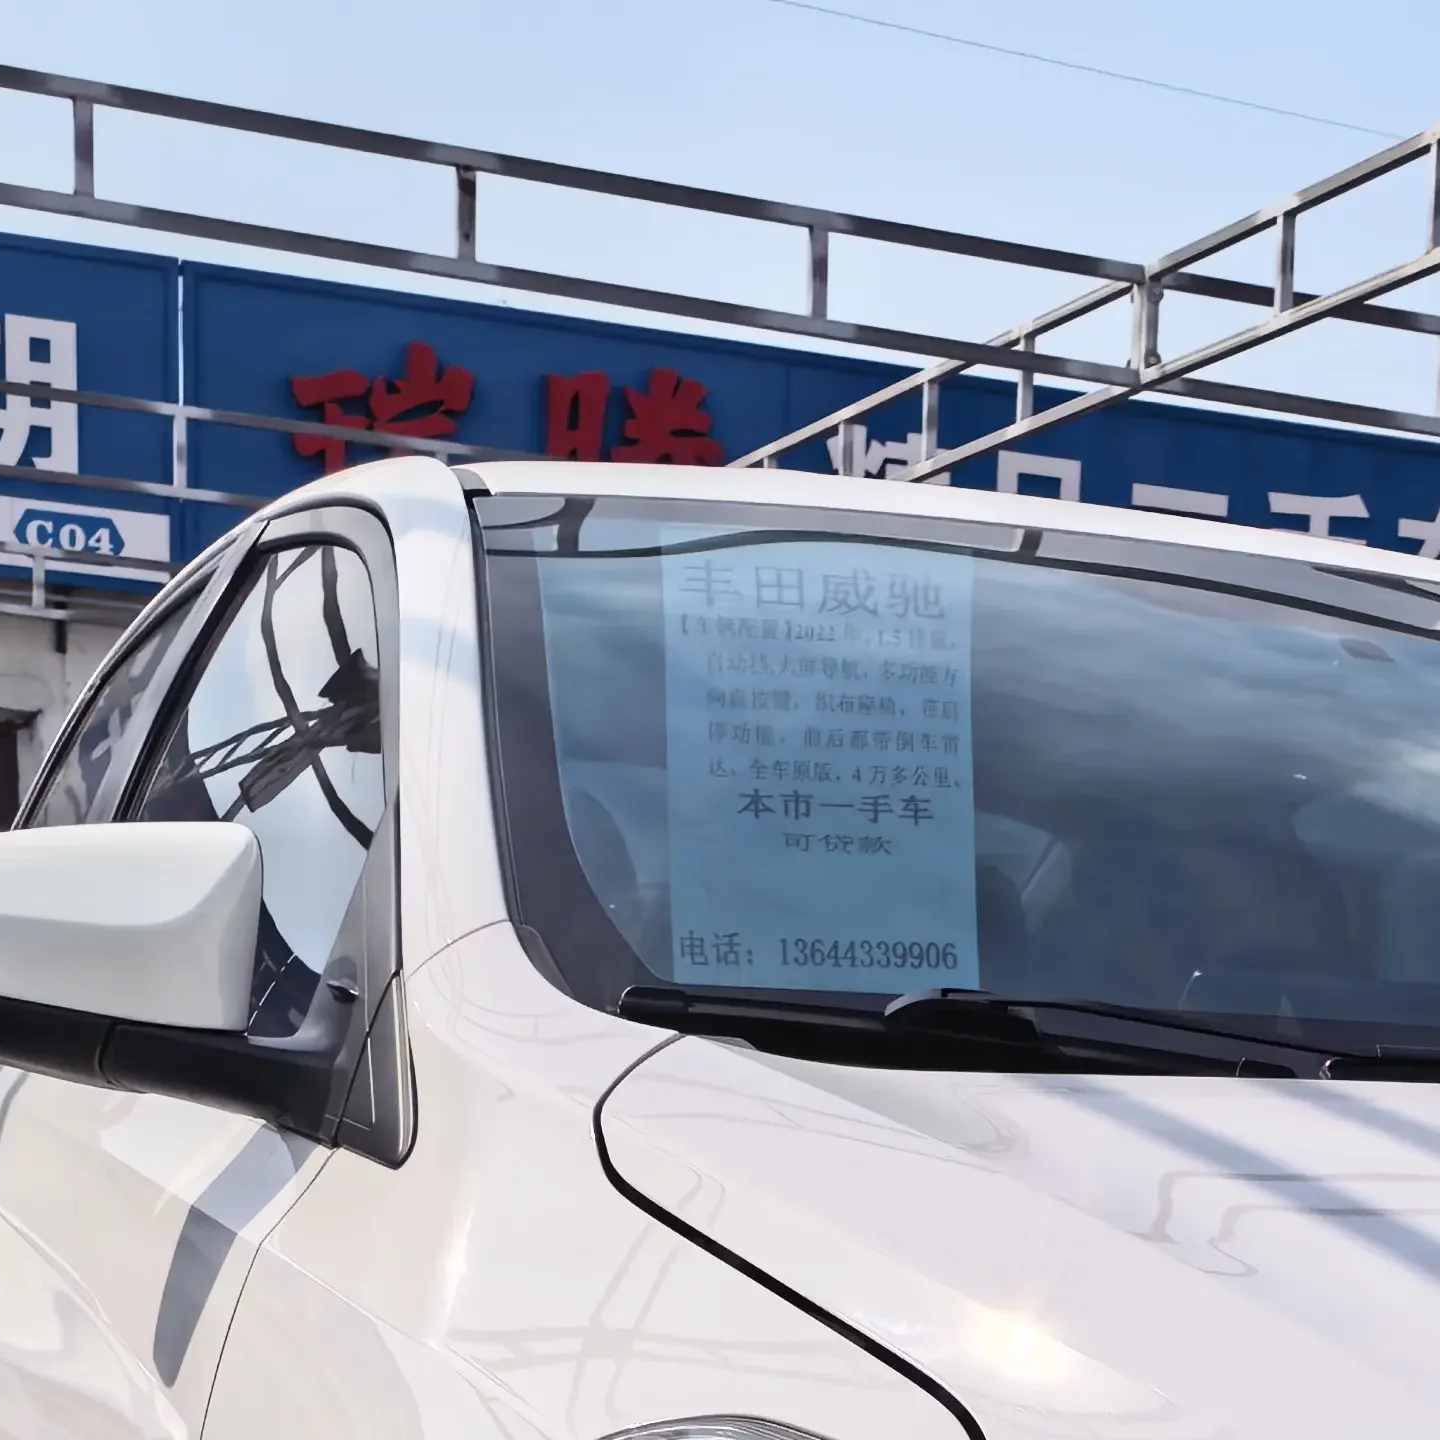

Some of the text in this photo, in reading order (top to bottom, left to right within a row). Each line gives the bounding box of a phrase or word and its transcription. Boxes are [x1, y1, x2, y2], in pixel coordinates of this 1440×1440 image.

[24, 518, 116, 556] C04
[677, 559, 946, 620] 丰田威驰
[736, 787, 935, 827] 本市一手车
[781, 831, 894, 856] 可贷款
[779, 938, 959, 970] 13644339906
